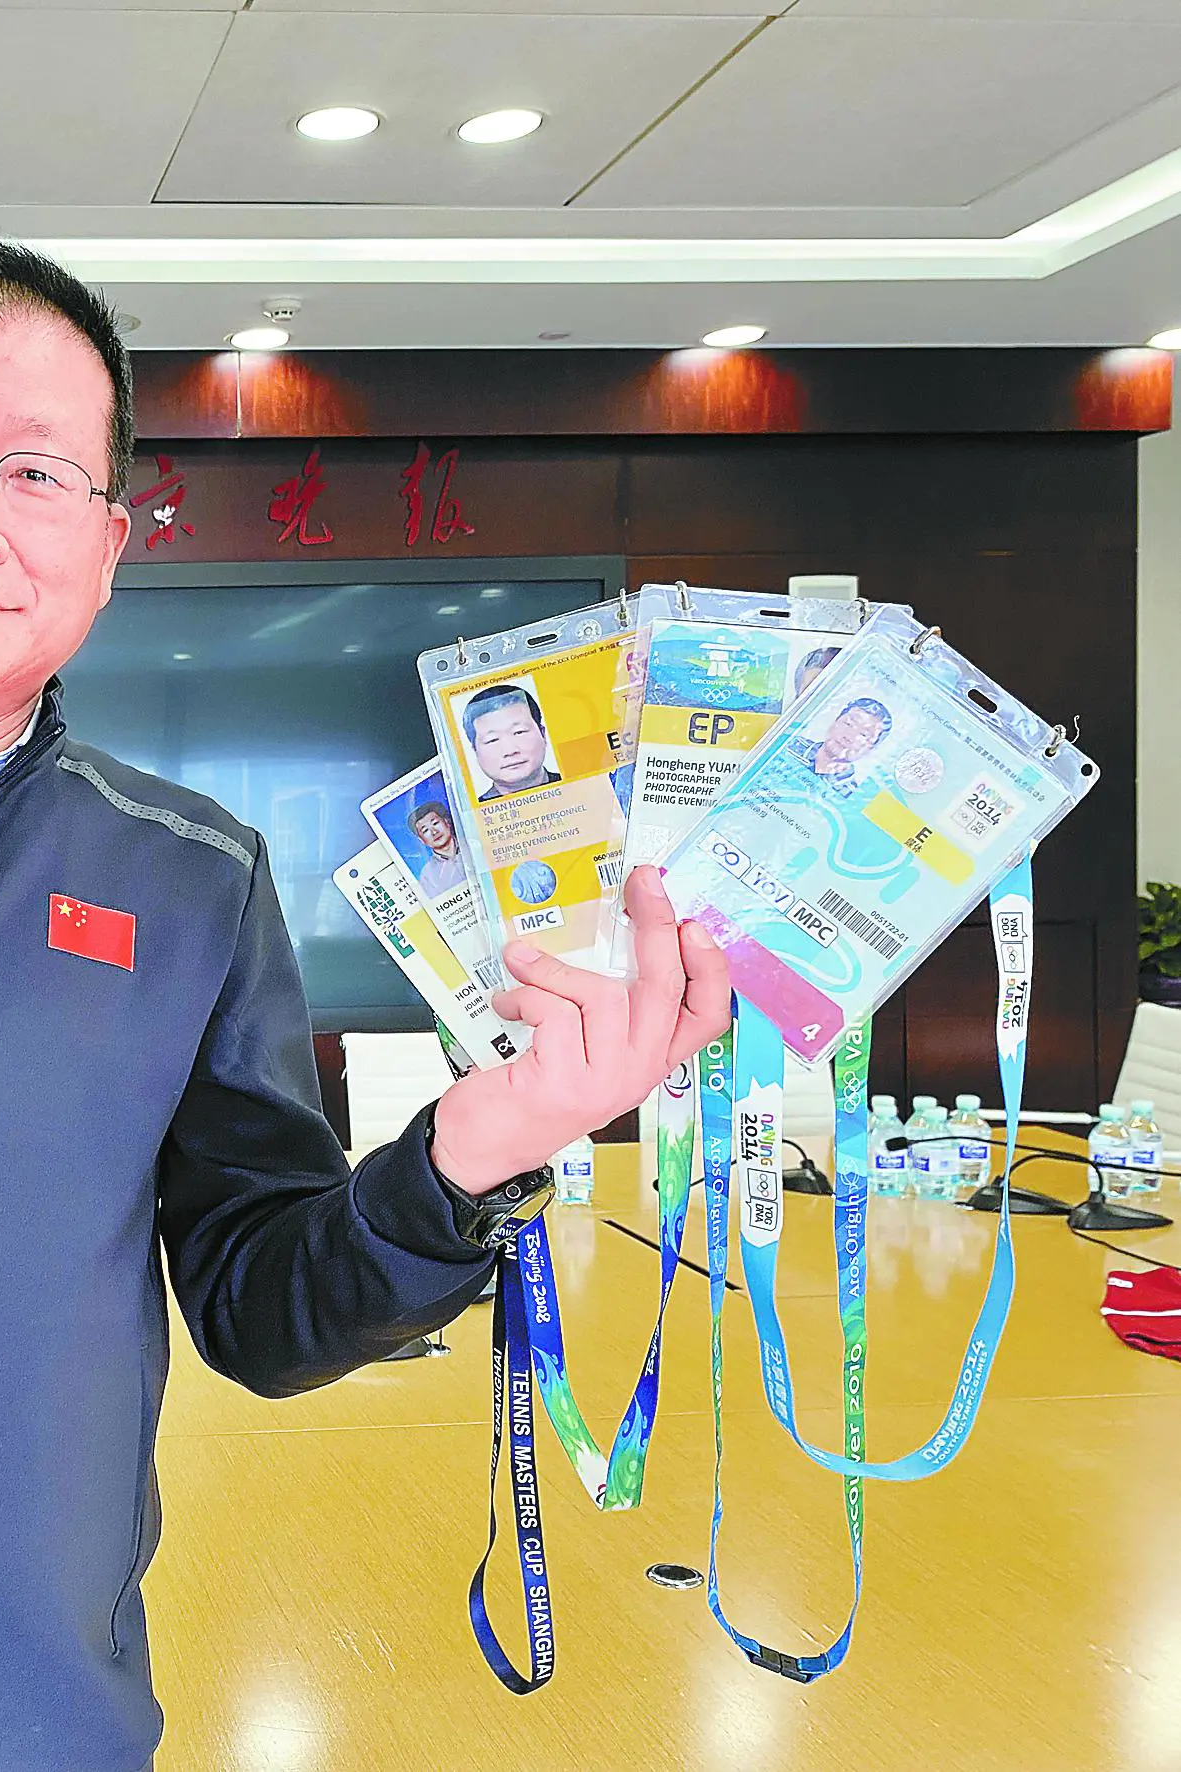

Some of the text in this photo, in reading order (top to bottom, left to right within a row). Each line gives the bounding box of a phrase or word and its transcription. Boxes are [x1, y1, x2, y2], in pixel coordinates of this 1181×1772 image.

[687, 712, 735, 745] EP
[645, 770, 721, 786] PHOTOGRAPHER
[646, 756, 706, 773] Hongheng
[708, 761, 740, 774] YUAN
[480, 788, 563, 817] YUAN HONGHENG
[642, 793, 676, 805] BEIJING
[967, 793, 1003, 826] 2014
[486, 805, 588, 838] MPC SUPPORT PERSONNEL
[915, 826, 933, 843] E
[492, 827, 581, 857] BEIJING EVENING NEWS
[520, 911, 557, 931] MPC
[793, 906, 834, 941] MPC
[870, 909, 909, 943] 0051722-01
[1002, 917, 1010, 937] YOG
[1010, 917, 1019, 937] DNA
[1011, 980, 1028, 1028] 2014
[801, 1023, 823, 1042] 4
[741, 1113, 759, 1161] 2014
[754, 1203, 763, 1224] DNA
[764, 1206, 774, 1226] YOG
[524, 1227, 551, 1324] Beijing 2008
[849, 1343, 863, 1414] 2010
[958, 1339, 986, 1400] 2014
[932, 1350, 988, 1465] YOUTH OLYMPIC GAMES
[512, 1370, 552, 1680] TENNIS MASTERS CUP SHANGHAI
